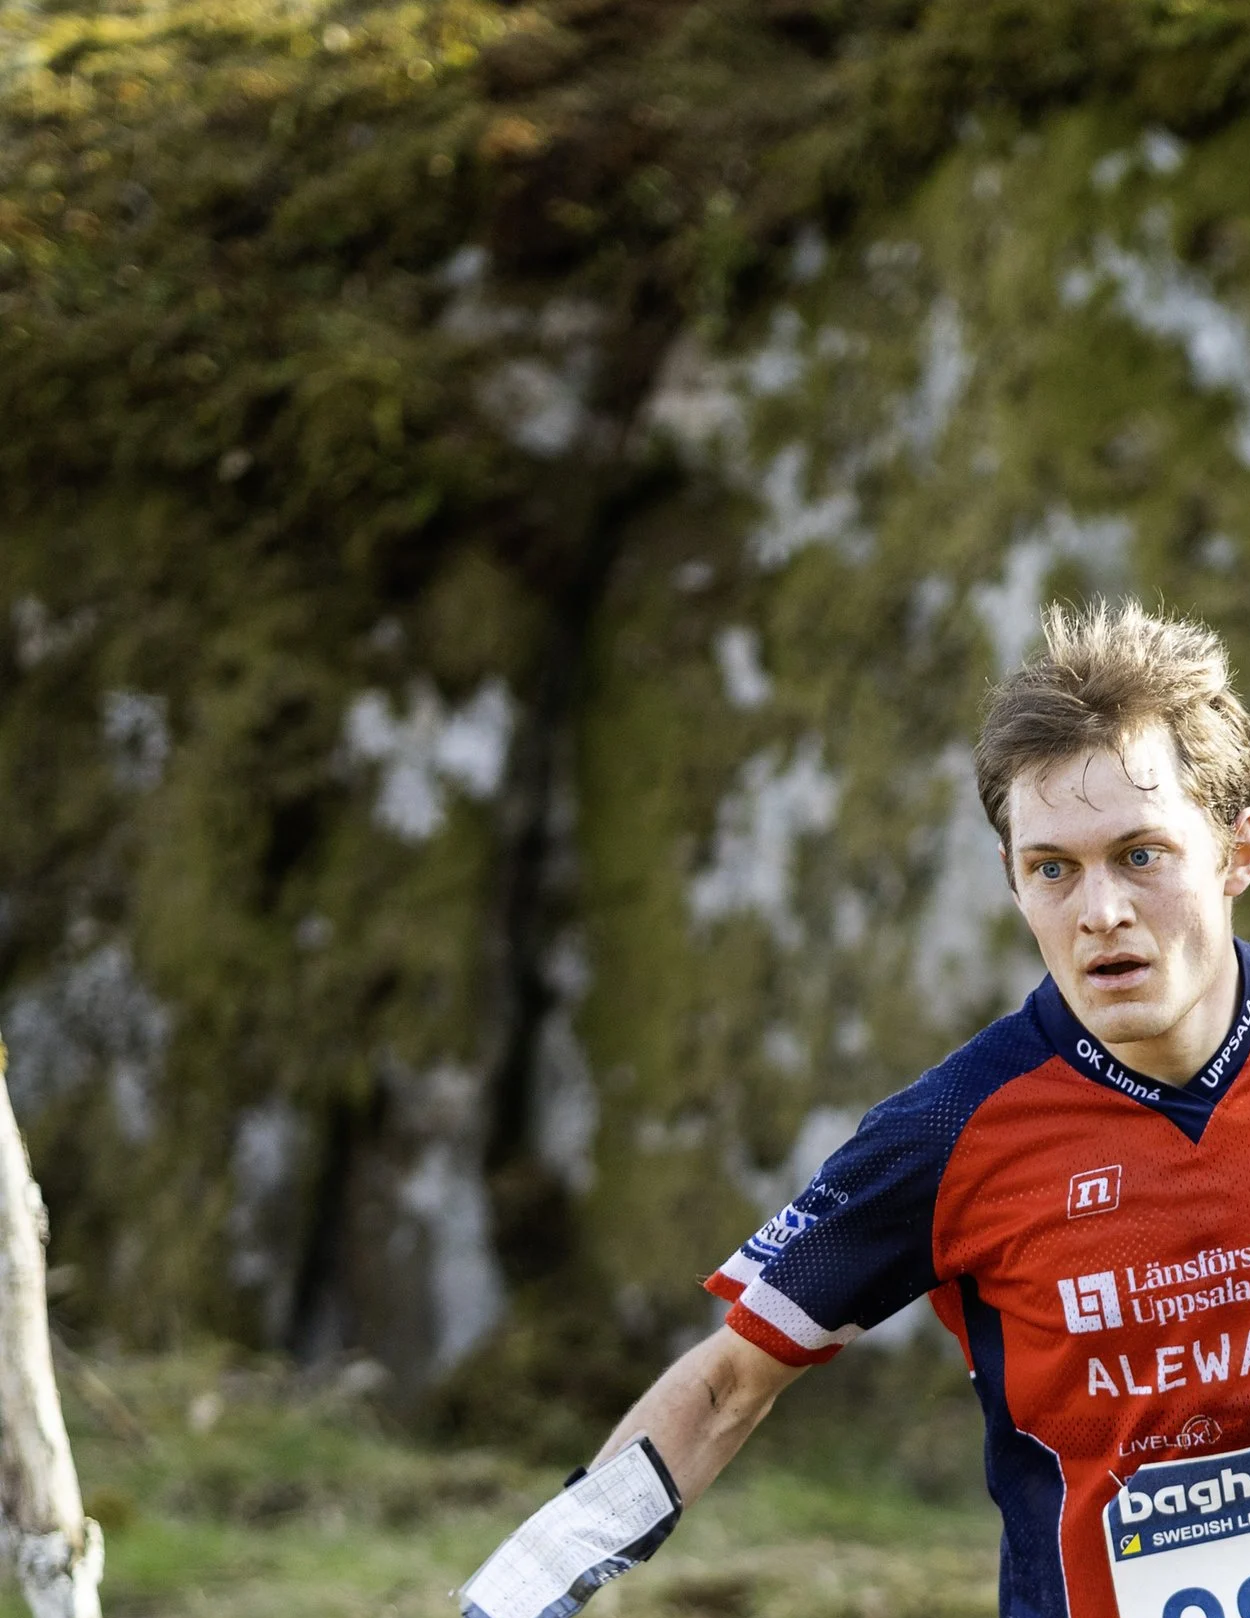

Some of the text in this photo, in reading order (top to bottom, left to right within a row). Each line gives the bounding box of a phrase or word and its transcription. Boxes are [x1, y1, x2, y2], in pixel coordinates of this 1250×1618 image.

[1076, 1038, 1160, 1101] OK Linné
[1119, 1431, 1206, 1457] LIVELOX
[1152, 1517, 1234, 1547] SWEDISH
